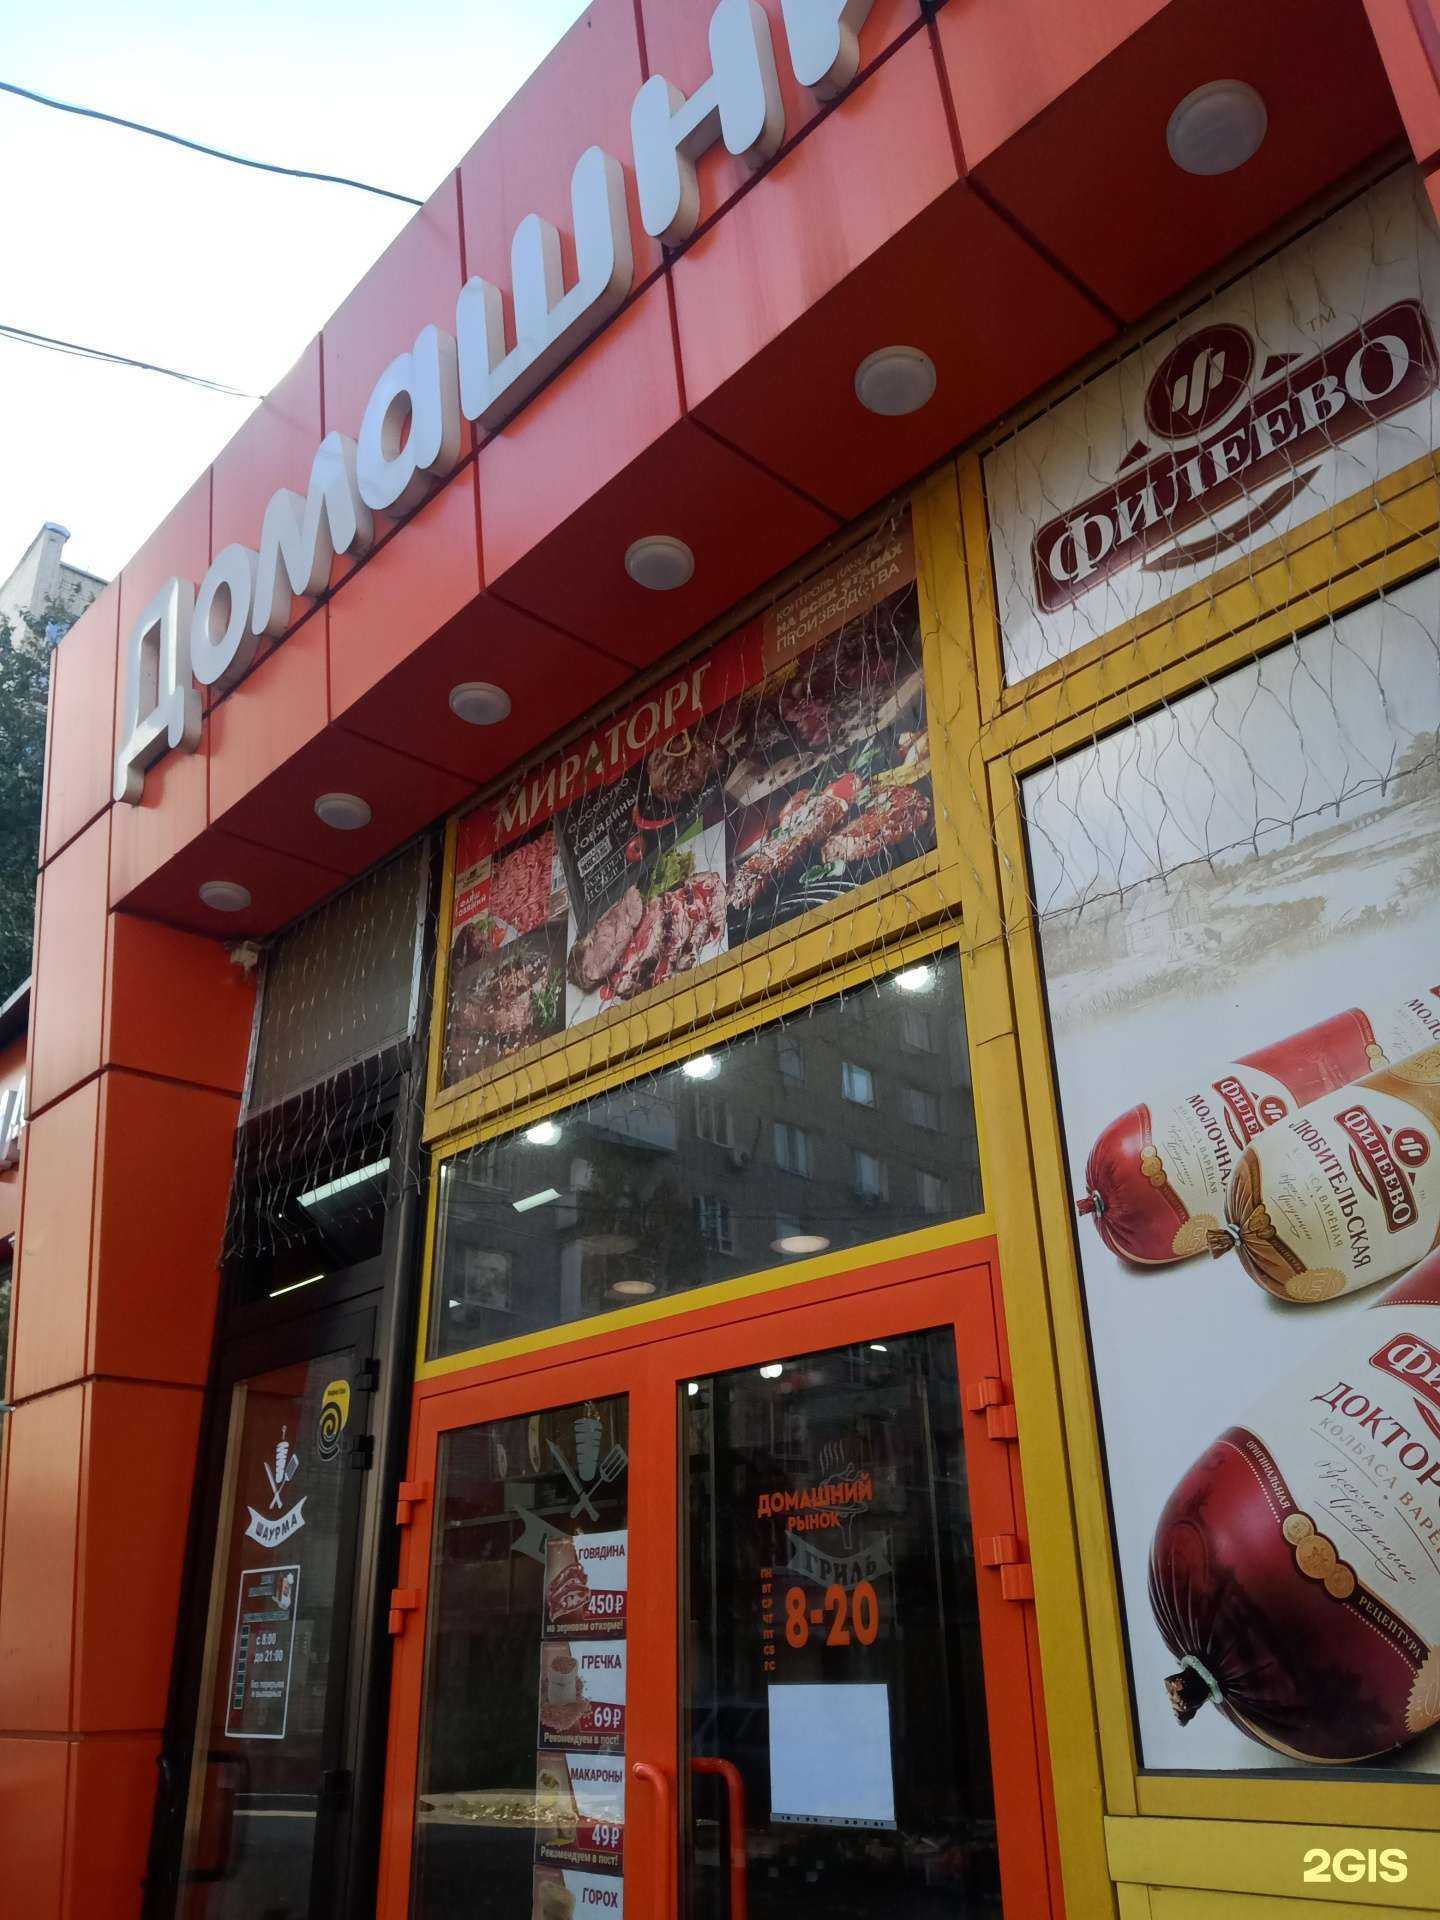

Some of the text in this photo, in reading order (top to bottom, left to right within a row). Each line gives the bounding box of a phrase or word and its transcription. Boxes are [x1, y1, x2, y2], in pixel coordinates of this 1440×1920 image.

[1048, 334, 1411, 585] ФИЛЕЕВО
[495, 661, 711, 838] МИРАТОРГ
[1288, 1119, 1371, 1269] ЛЮБИТЕЛЬСКАЯ
[1344, 1110, 1412, 1224] ФИЛЕЕВО
[1245, 1440, 1290, 1510] ОРИГИНАЛЬНАЯ
[1318, 1417, 1398, 1490] КОЛБАСА
[757, 1472, 873, 1519] ДОМАШНИЙ
[787, 1511, 841, 1533] РЫНОК
[578, 1544, 626, 1561] ГОВЯДИНА
[804, 1549, 877, 1583] ГРИЛЬ
[785, 1578, 880, 1649] 8-20
[1358, 1595, 1422, 1659] РЕЦЕПТУРА
[581, 1654, 622, 1670] ГРЕЧКА
[570, 1767, 623, 1784] МАКАРОНЫ
[582, 1887, 618, 1909] ГОРОХ
